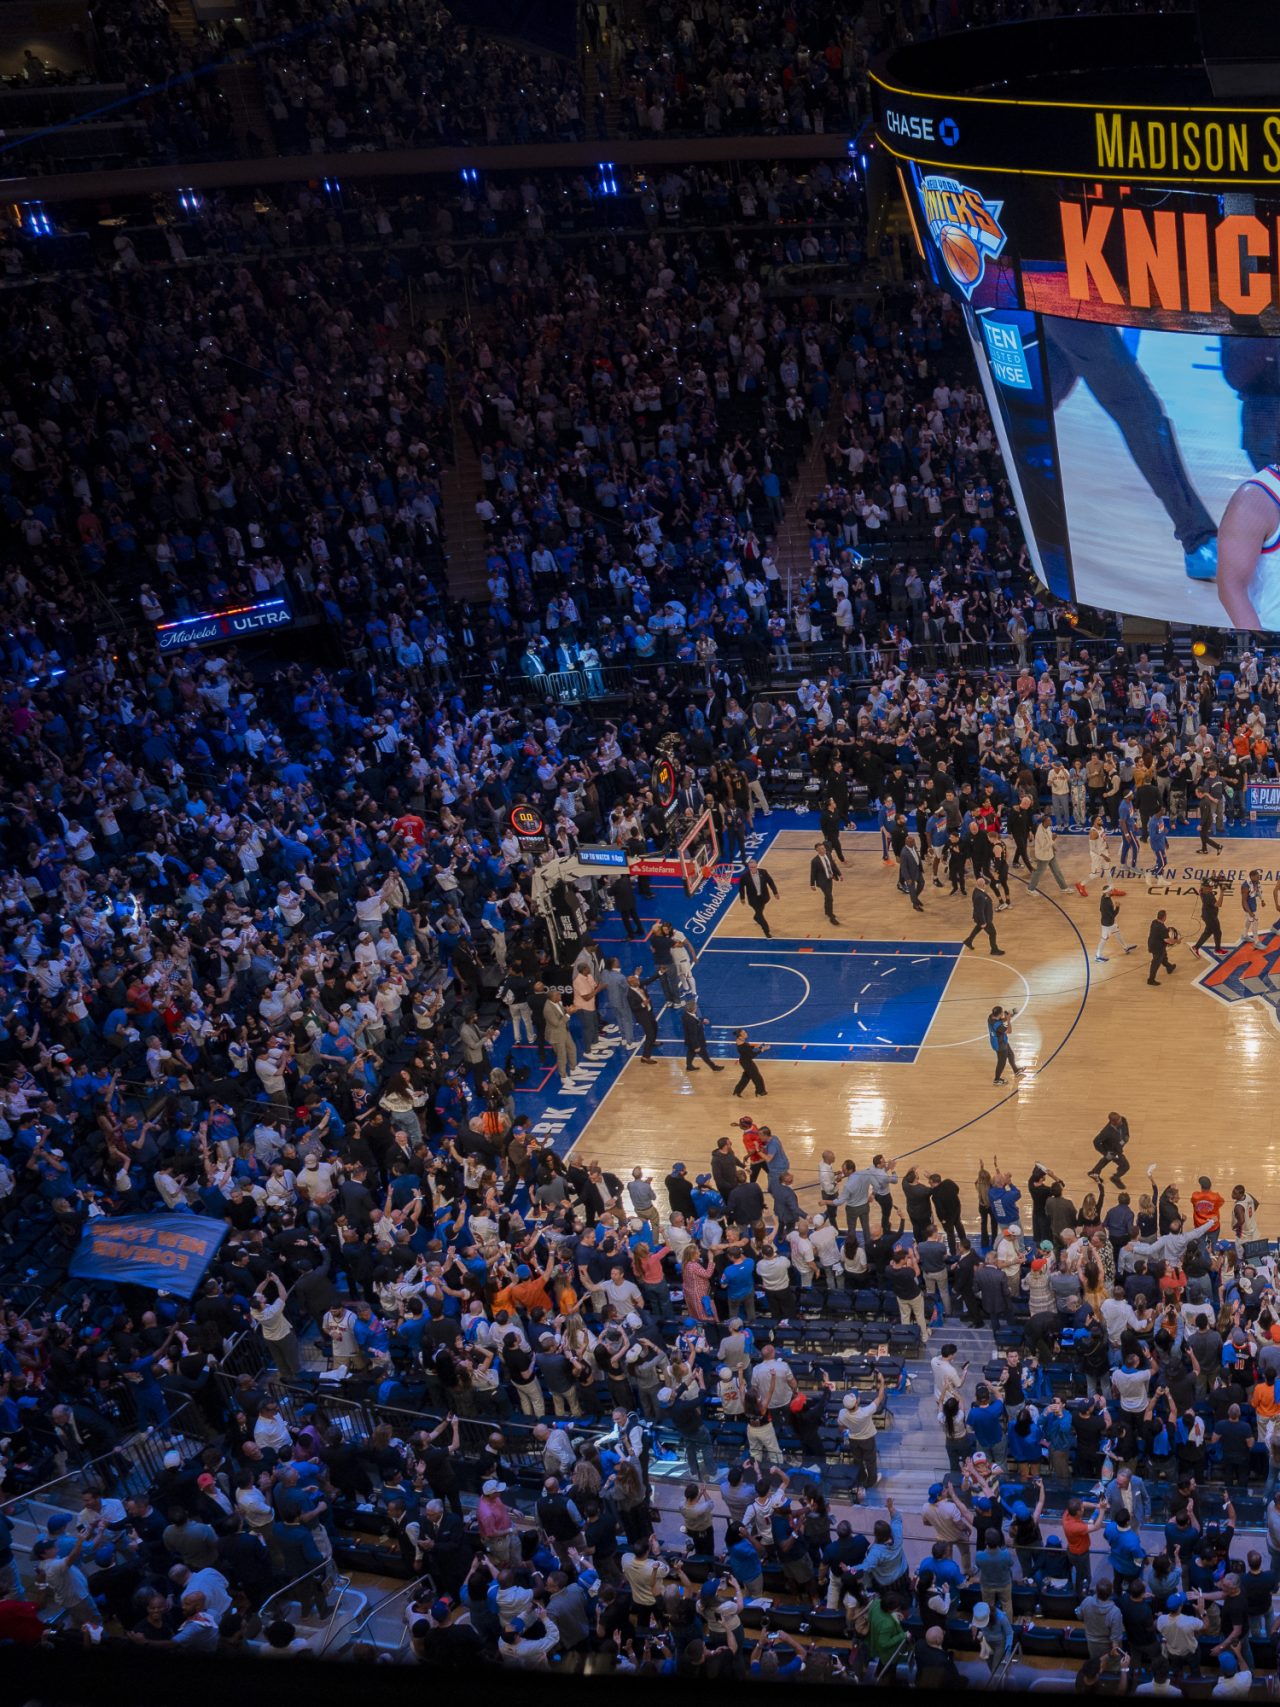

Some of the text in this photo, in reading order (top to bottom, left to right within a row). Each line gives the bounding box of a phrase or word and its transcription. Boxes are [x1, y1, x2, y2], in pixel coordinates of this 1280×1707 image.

[886, 110, 935, 141] CHASE
[1095, 113, 1249, 172] MADISON
[985, 323, 1017, 349] TEN
[160, 611, 291, 648] Michelob ULTRA
[1147, 886, 1234, 897] CHAE
